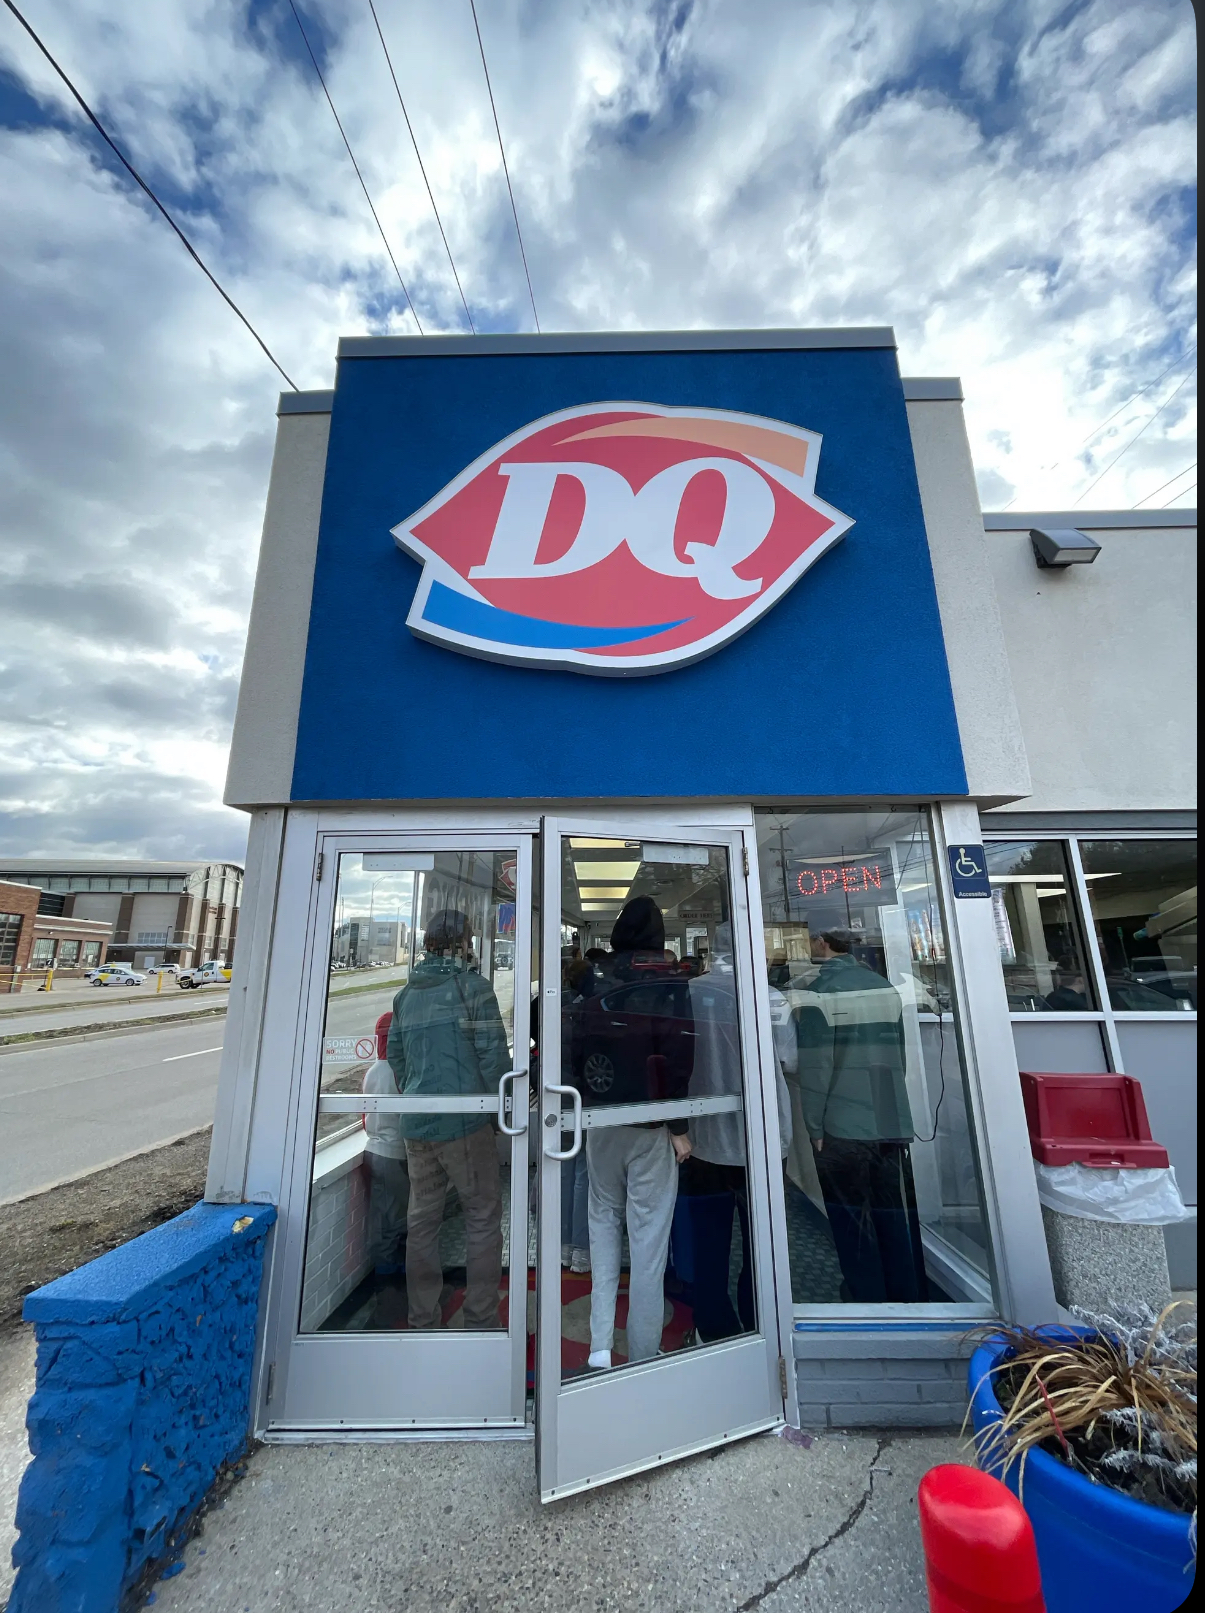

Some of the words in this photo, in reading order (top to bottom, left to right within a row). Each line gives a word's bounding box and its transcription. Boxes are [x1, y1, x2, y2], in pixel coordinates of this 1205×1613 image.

[467, 456, 776, 600] DQ
[797, 865, 882, 895] OPEN
[326, 1039, 357, 1048] SORRY
